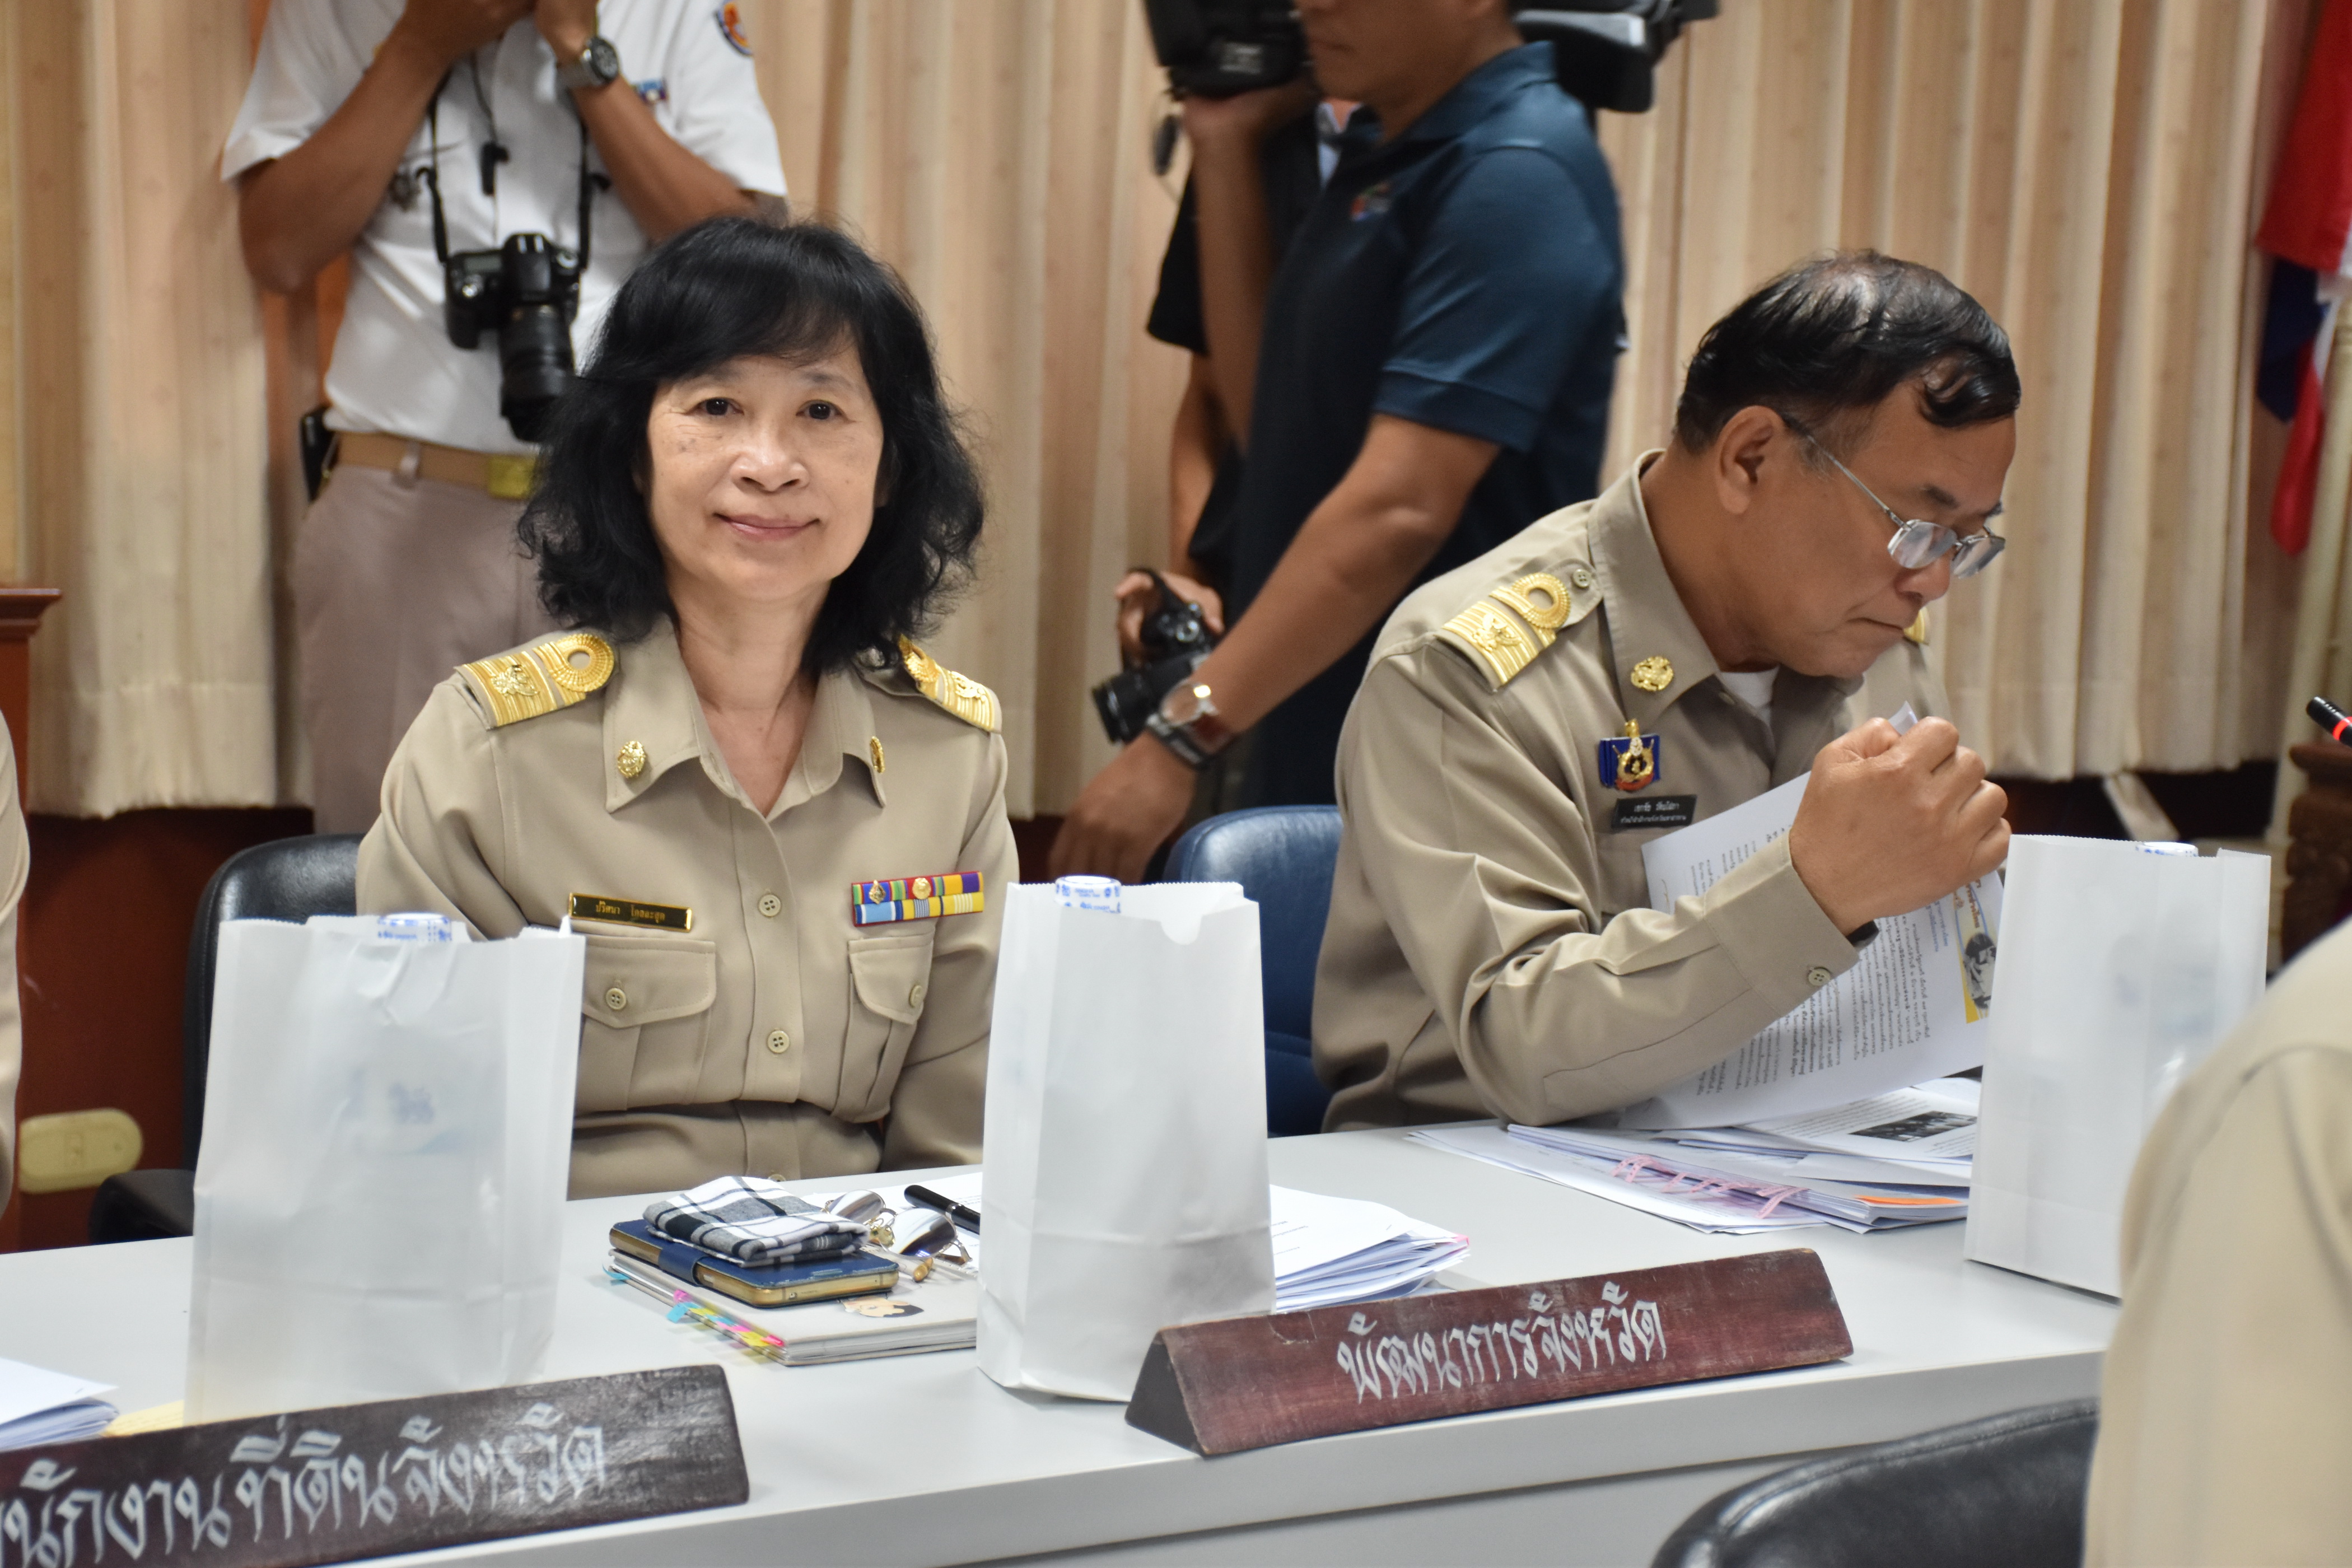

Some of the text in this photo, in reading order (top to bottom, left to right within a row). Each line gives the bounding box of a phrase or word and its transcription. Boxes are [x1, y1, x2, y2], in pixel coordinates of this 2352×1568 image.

[1337, 1280, 1667, 1404] พัฒนาการจังหวัด
[0, 1402, 605, 1568] นักงานที่ดินจังหวัด
